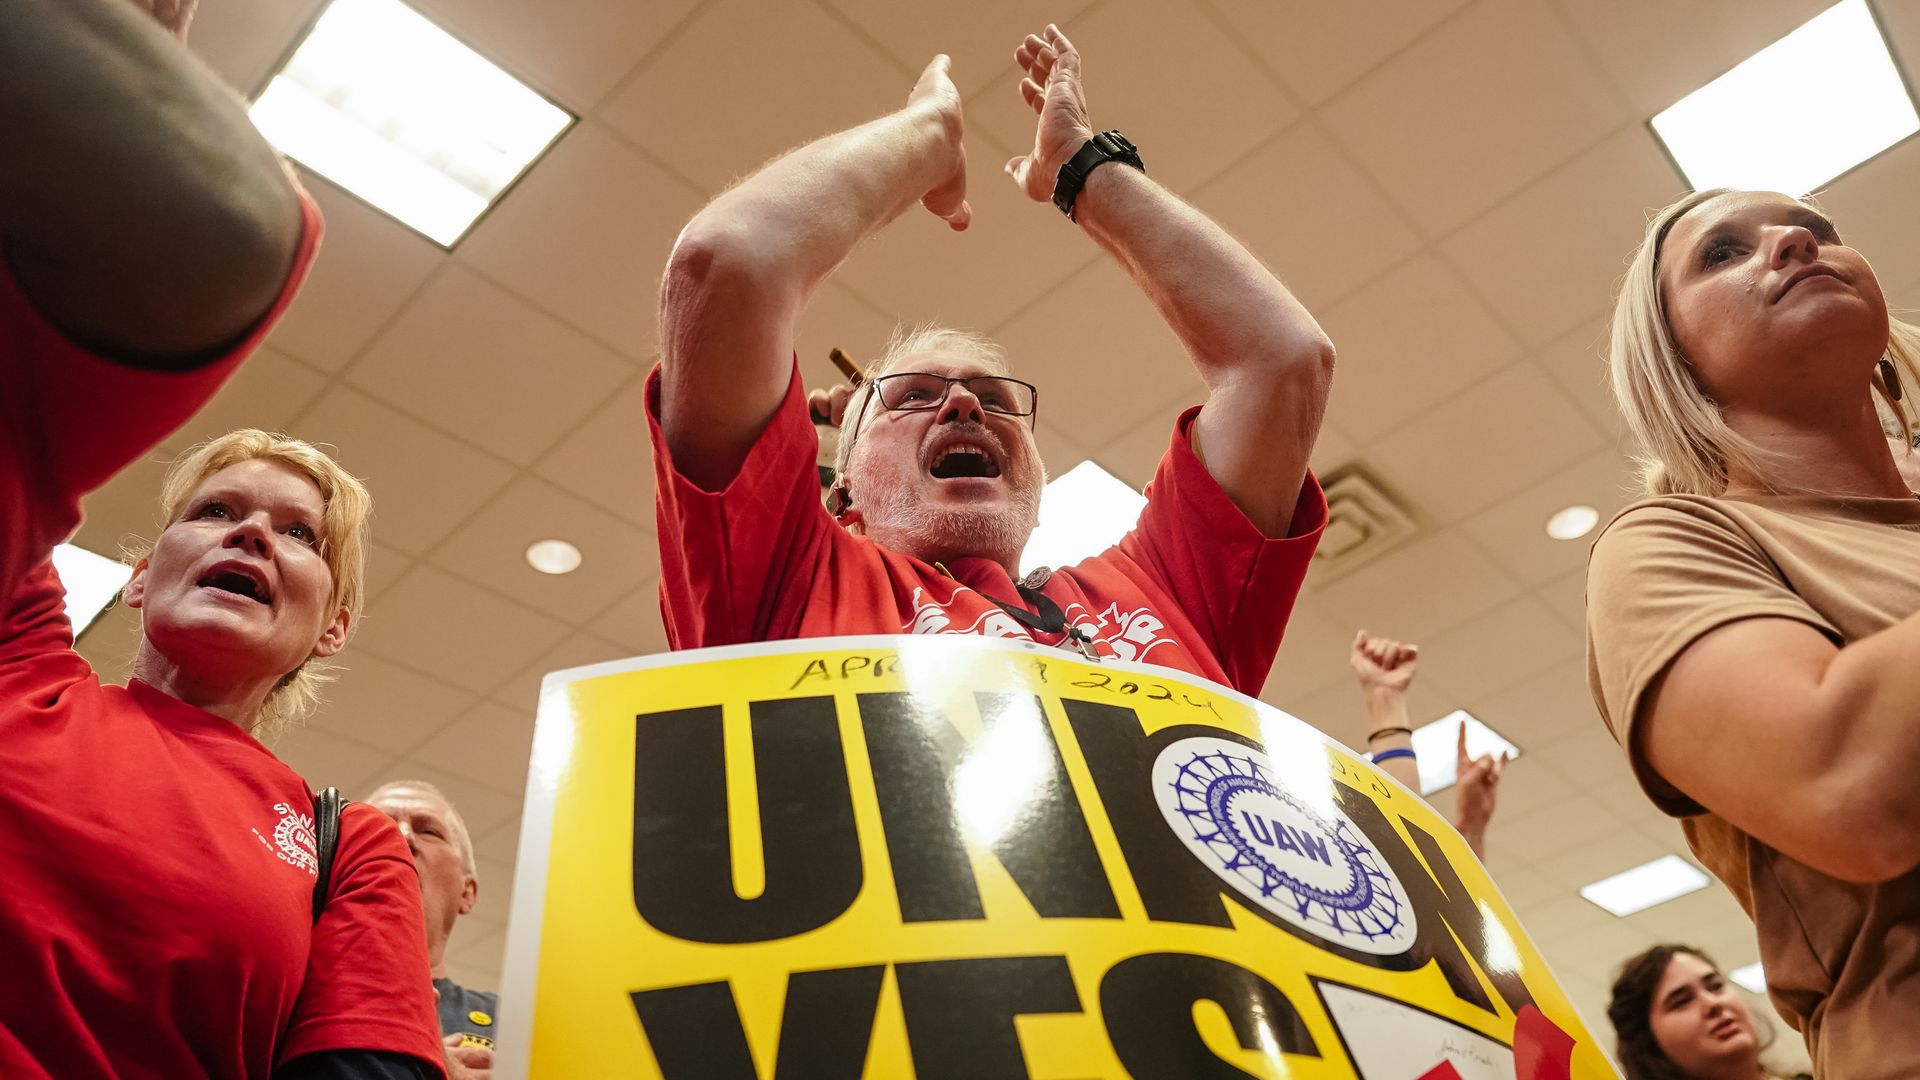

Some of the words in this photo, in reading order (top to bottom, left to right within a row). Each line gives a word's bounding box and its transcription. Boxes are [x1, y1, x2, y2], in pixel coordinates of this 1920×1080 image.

[1071, 673, 1223, 720] 2024
[276, 851, 306, 869] OUR
[632, 692, 1538, 1018] UNION
[1241, 810, 1333, 867] UAW
